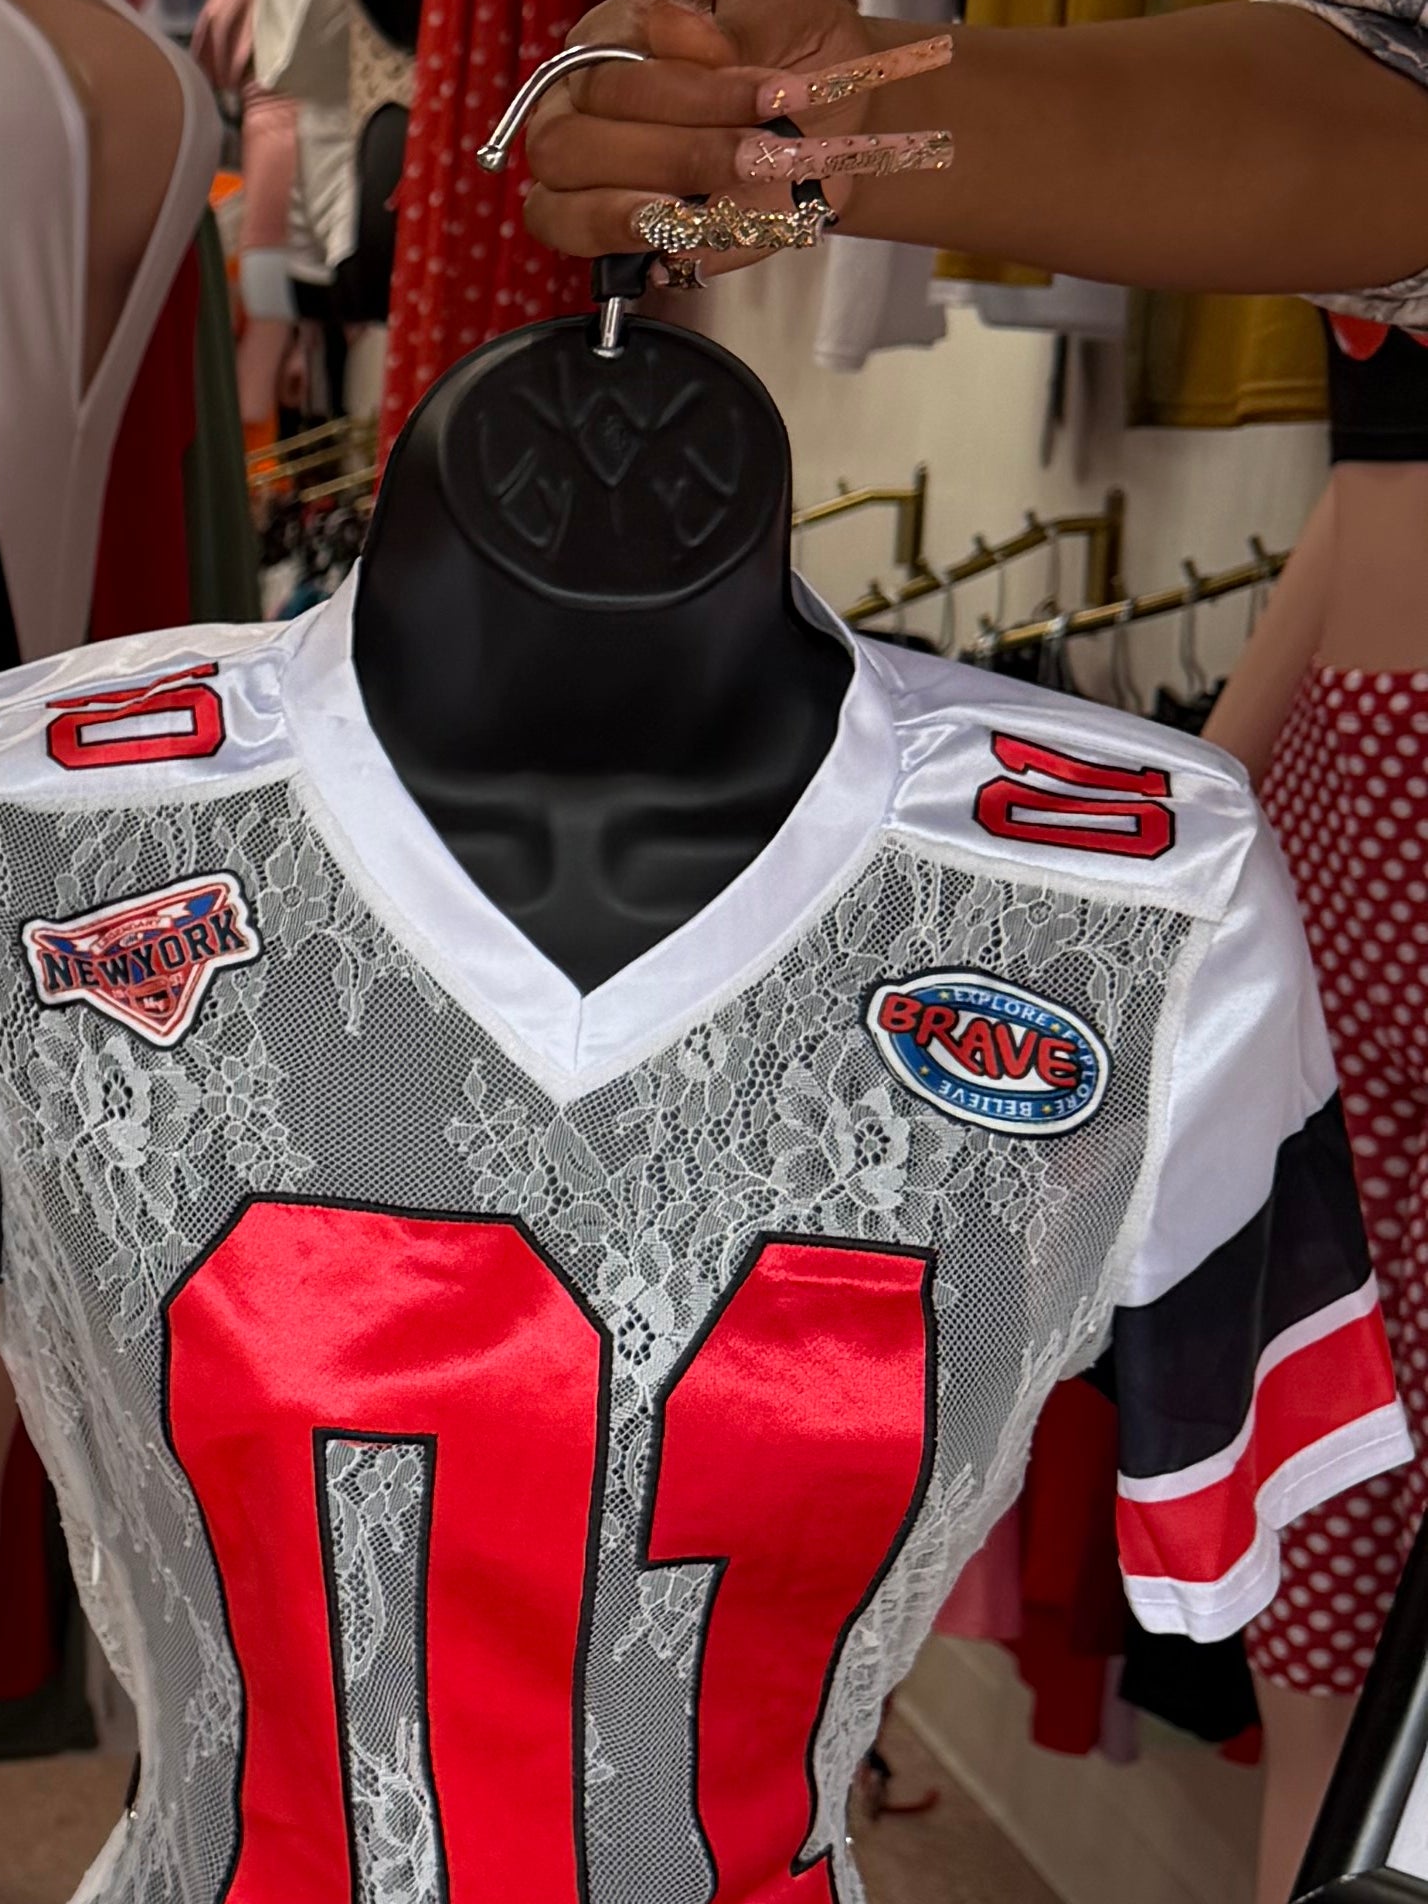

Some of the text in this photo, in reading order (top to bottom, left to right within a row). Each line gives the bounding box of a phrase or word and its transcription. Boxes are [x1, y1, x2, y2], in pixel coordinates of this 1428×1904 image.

[41, 908, 249, 992] NEWYORK
[953, 989, 1047, 1027] EXPLORE
[877, 992, 1081, 1088] BRAVE
[939, 1077, 1034, 1117] BELIEVE
